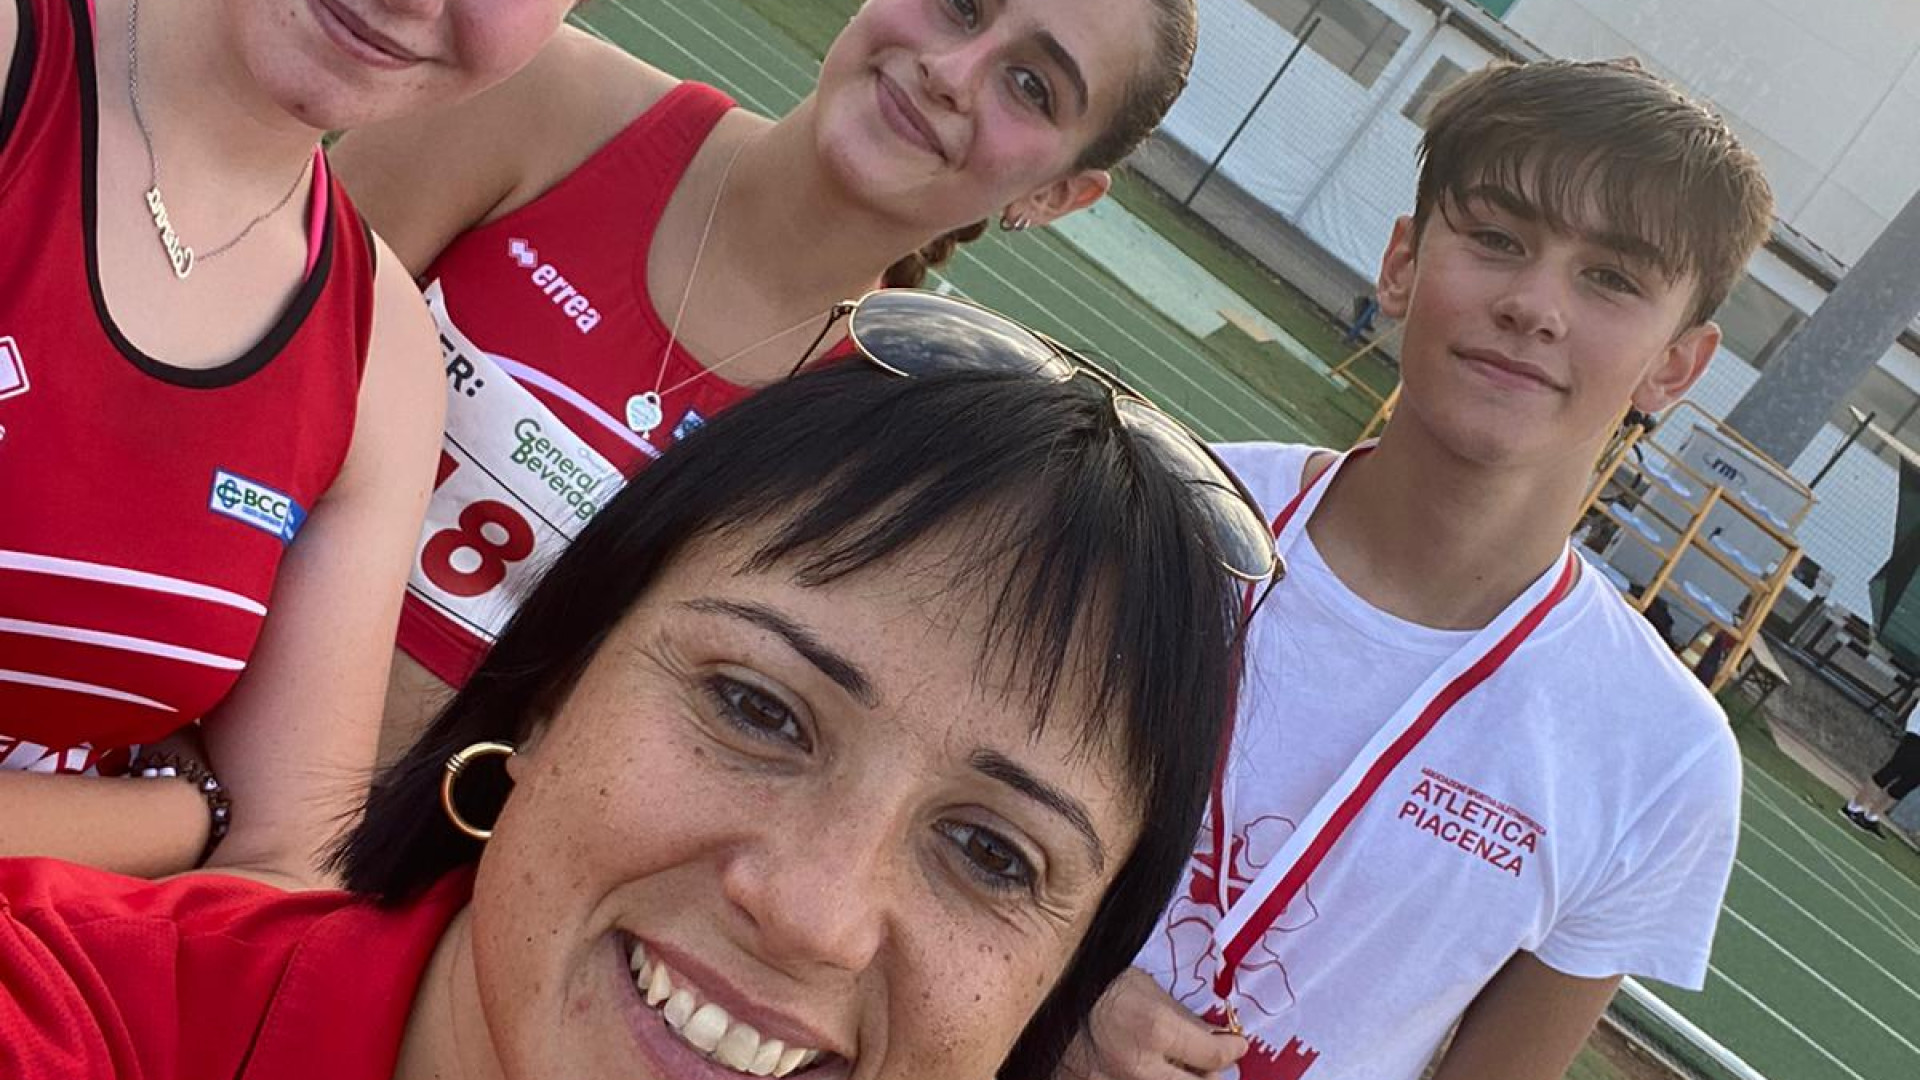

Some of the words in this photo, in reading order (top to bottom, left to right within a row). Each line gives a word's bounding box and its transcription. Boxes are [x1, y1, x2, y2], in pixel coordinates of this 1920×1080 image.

[531, 263, 603, 334] errea
[510, 440, 596, 520] Beverag
[515, 419, 602, 494] General
[243, 487, 287, 519] BCC
[421, 449, 535, 598] 8
[1398, 801, 1524, 877] PIACENZA
[1411, 779, 1537, 853] ATLETICA
